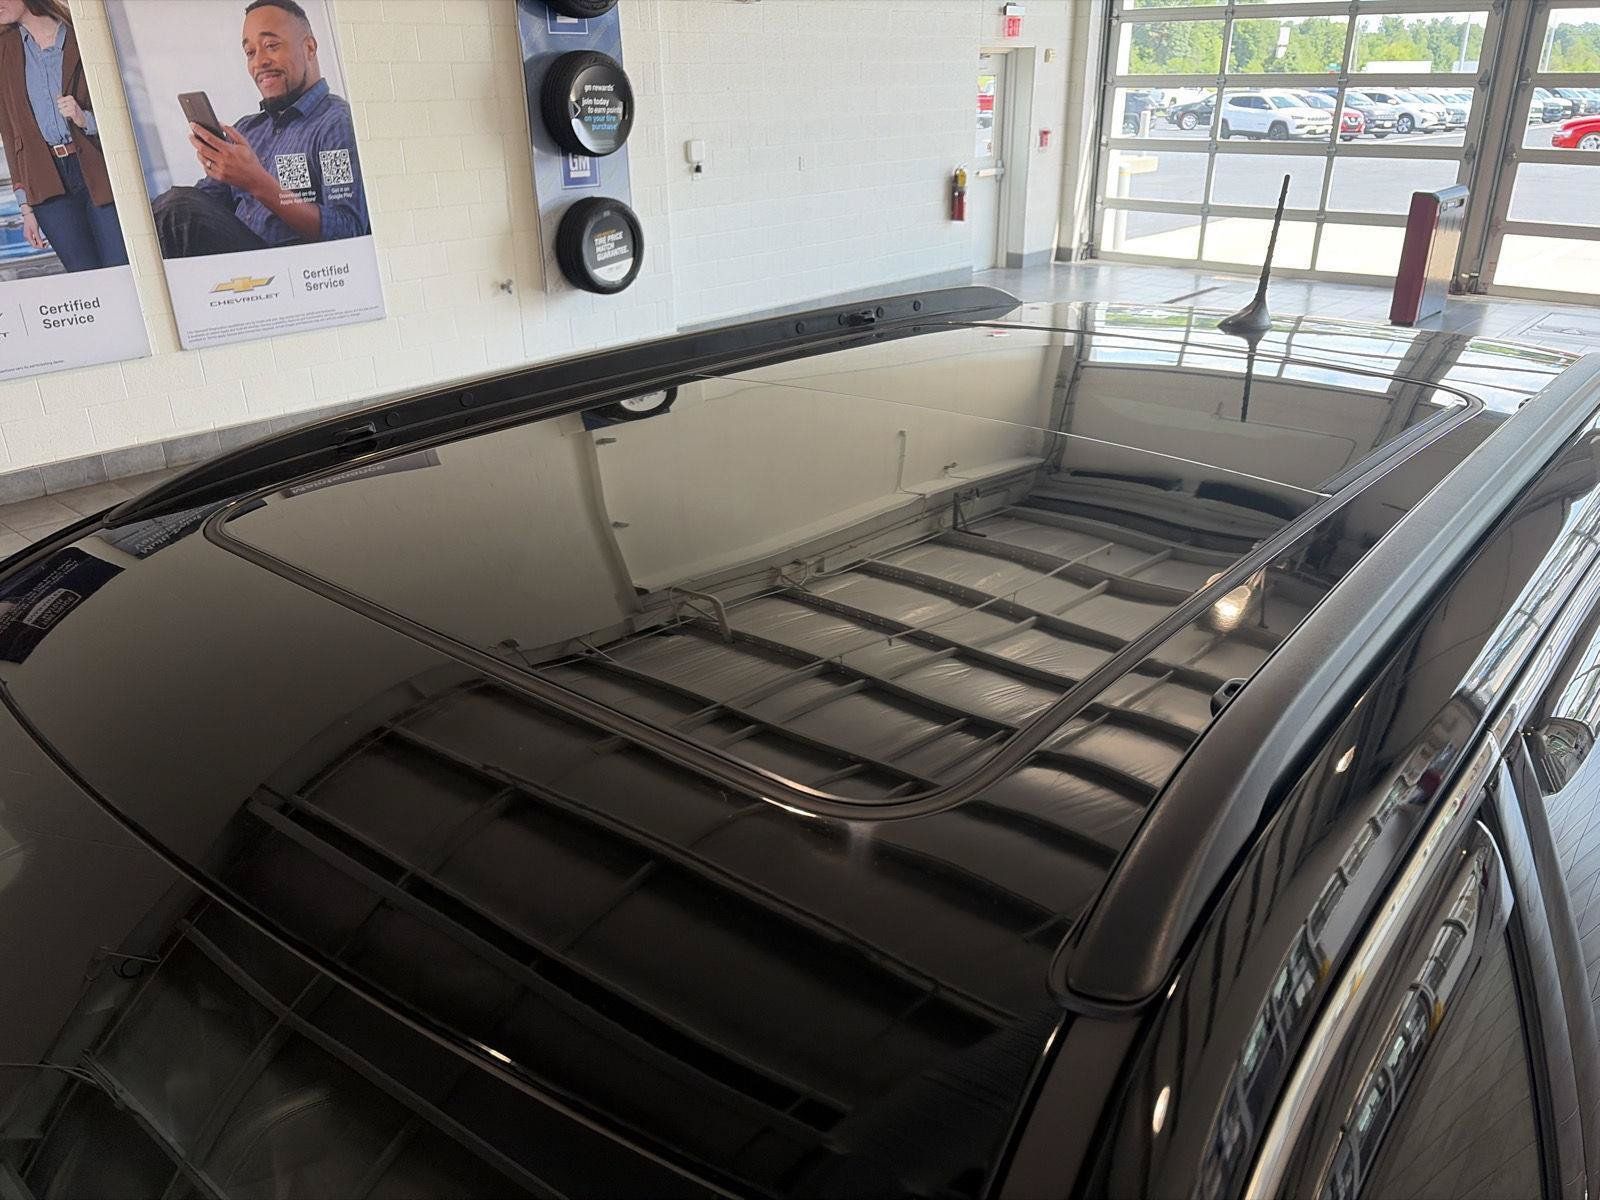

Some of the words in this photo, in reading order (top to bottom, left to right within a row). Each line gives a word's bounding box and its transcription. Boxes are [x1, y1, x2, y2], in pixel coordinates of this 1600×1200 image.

[582, 97, 593, 106] join
[593, 97, 609, 106] today
[587, 106, 594, 114] to
[592, 115, 605, 123] your
[605, 114, 617, 122] tire
[594, 236, 607, 247] TIRE
[607, 231, 624, 243] PRICE
[595, 242, 615, 254] MATCH
[302, 263, 350, 280] Certified
[305, 278, 345, 292] Service
[39, 296, 101, 316] Certified
[209, 292, 280, 307] CHEVROLET
[42, 313, 95, 330] Service
